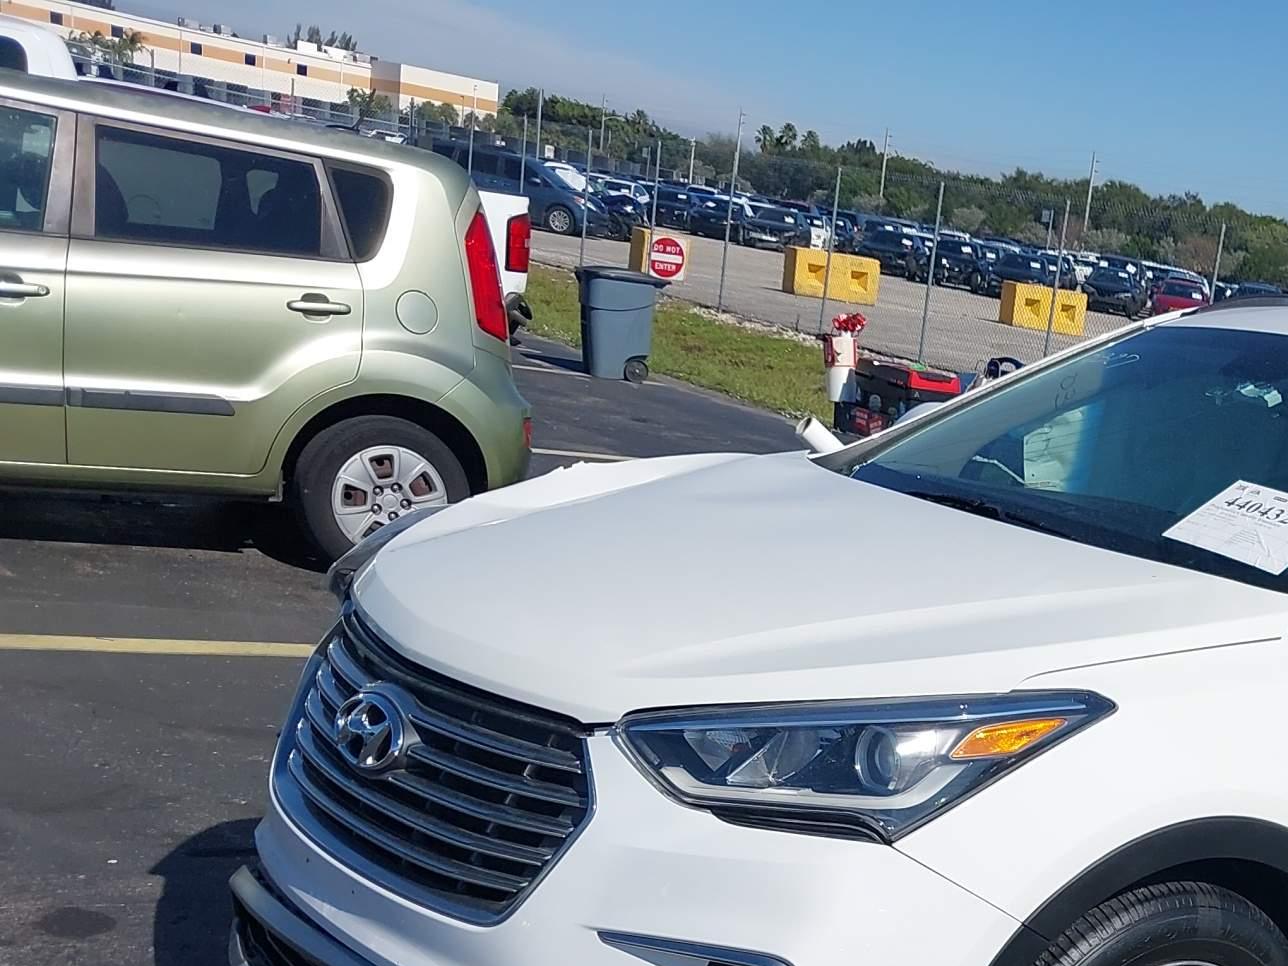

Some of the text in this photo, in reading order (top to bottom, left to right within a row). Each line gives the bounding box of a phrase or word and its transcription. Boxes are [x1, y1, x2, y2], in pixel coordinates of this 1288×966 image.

[653, 243, 681, 254] DO NOT
[654, 261, 677, 272] ENTER
